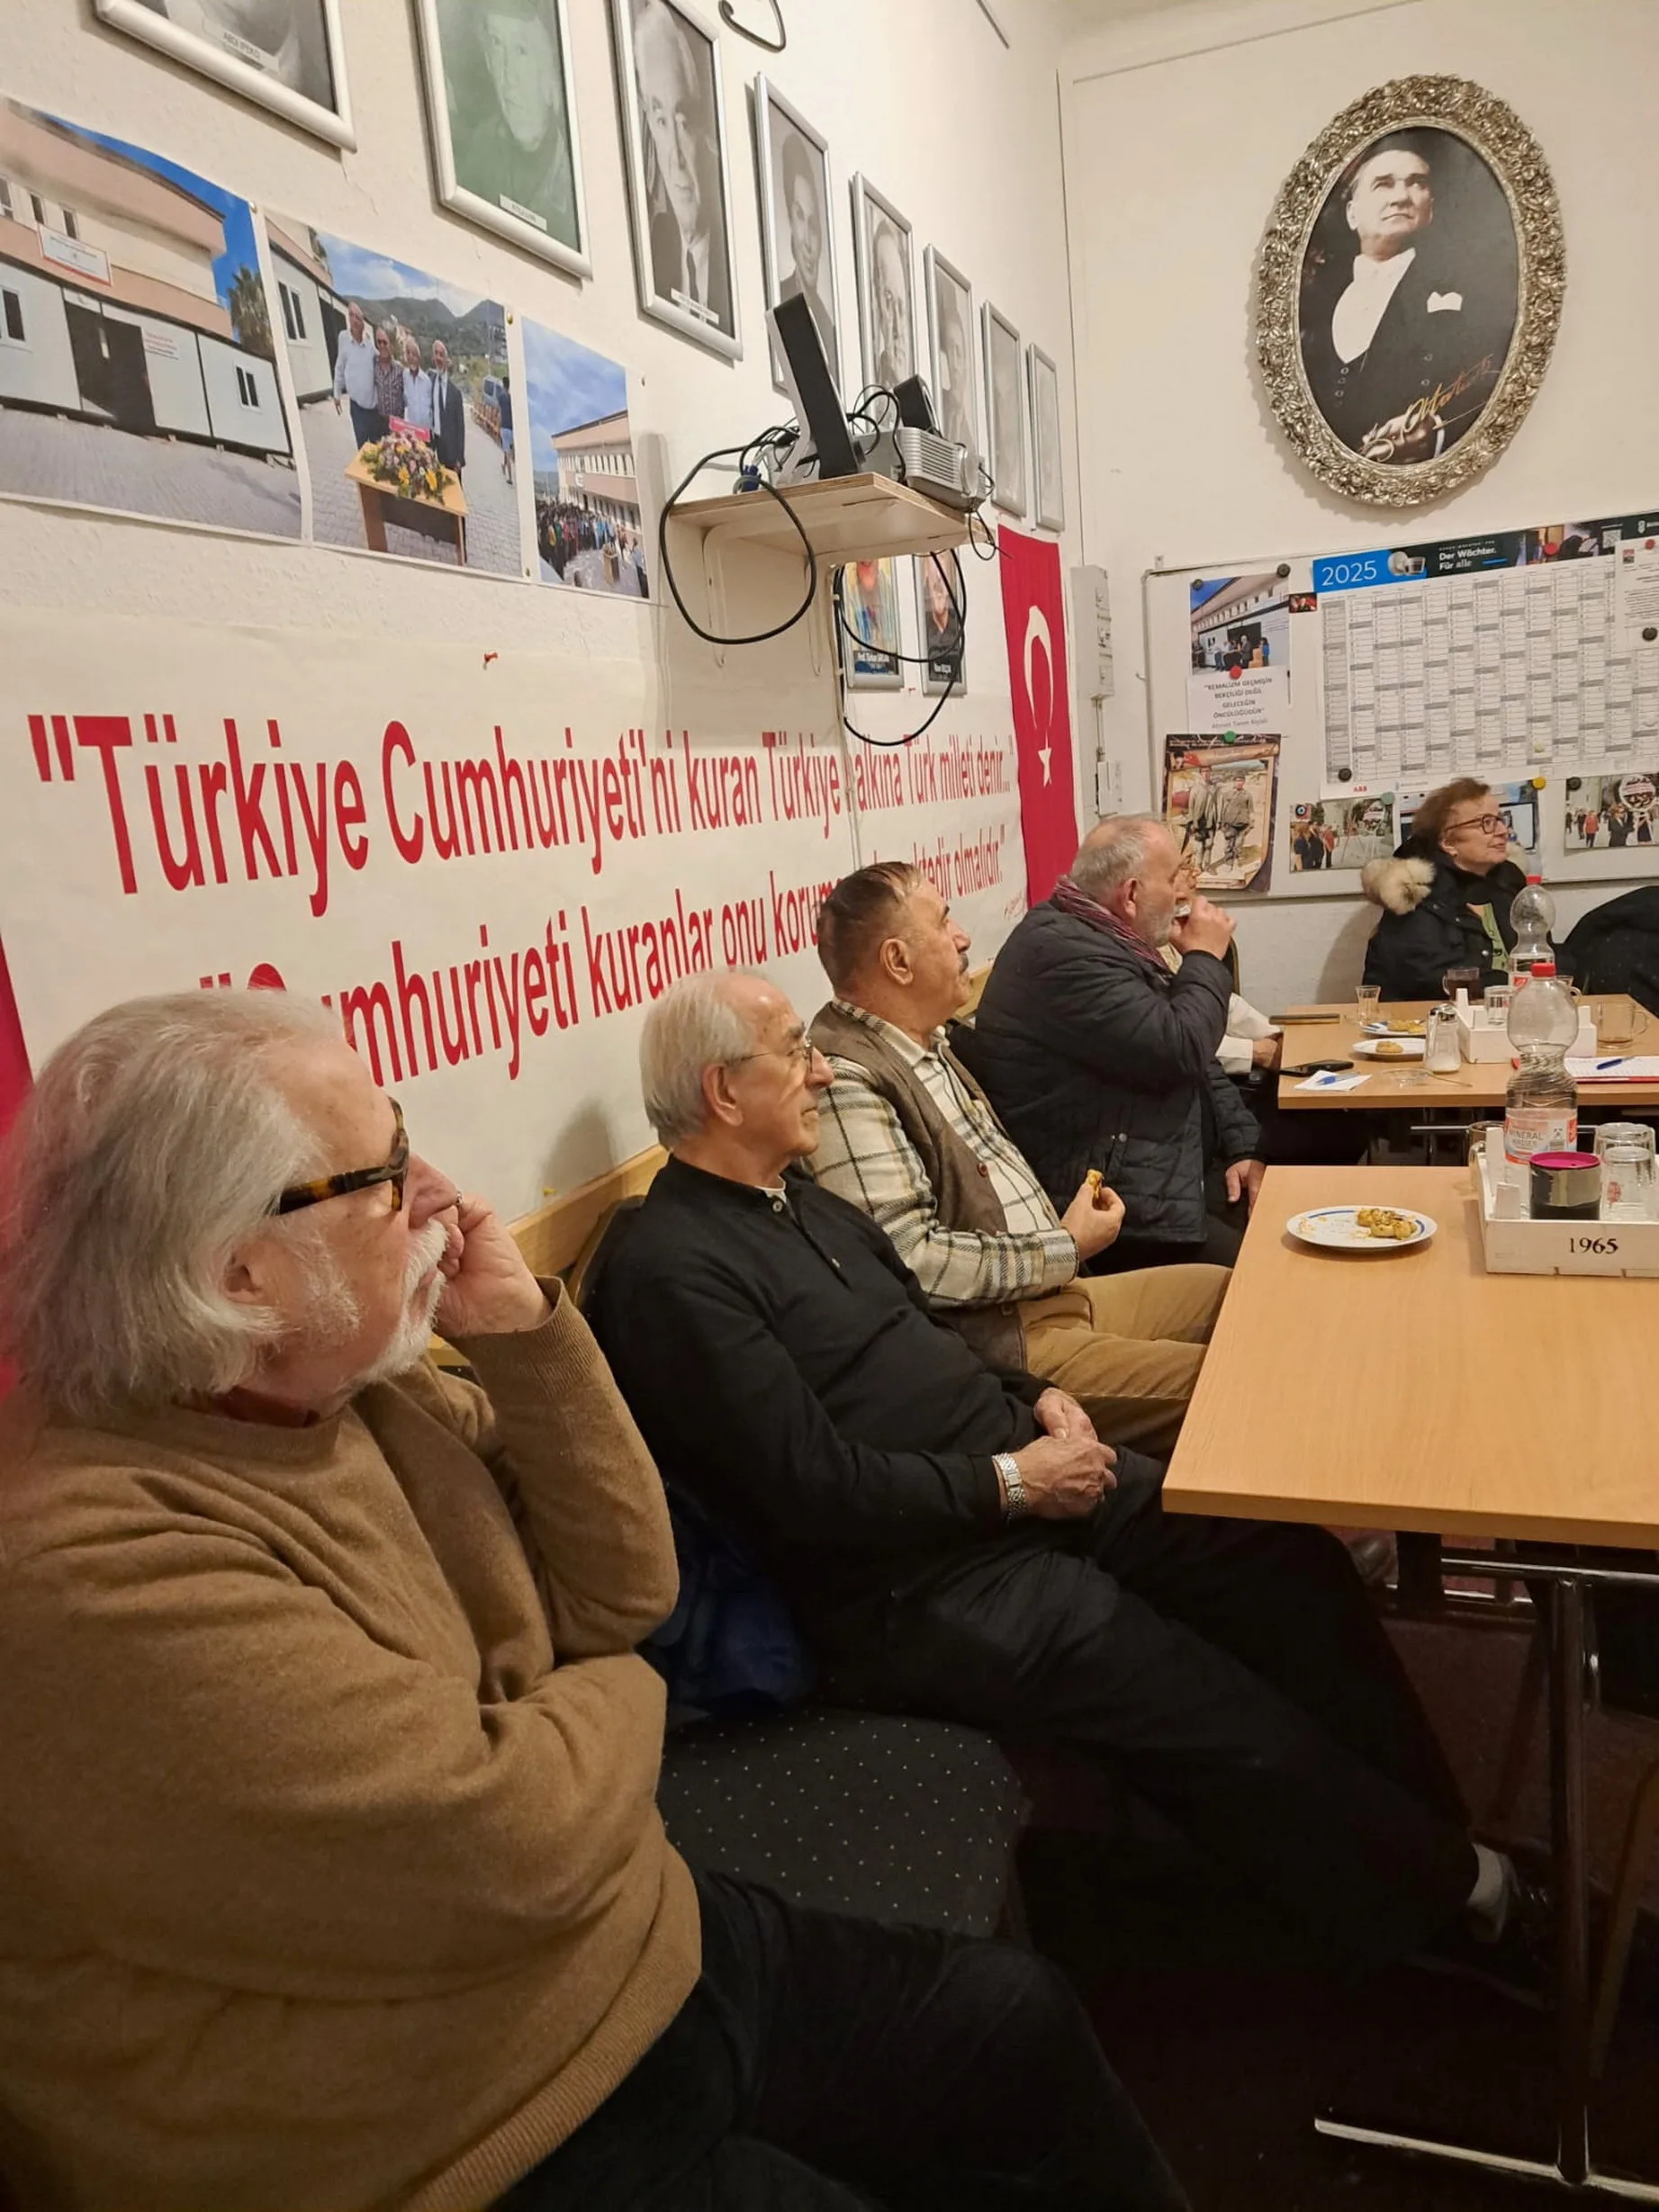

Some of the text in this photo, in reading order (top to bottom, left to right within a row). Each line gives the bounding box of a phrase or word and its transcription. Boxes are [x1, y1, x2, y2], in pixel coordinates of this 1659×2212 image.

[1438, 553, 1456, 561] Der
[1321, 560, 1377, 586] 2025
[1438, 562, 1454, 571] Für
[1353, 785, 1367, 793] ABB
[27, 714, 369, 918] "Türkiye
[382, 720, 682, 875] Cumhuriyeti'ni
[682, 730, 763, 831] kuran
[762, 731, 841, 839] Türkiye
[903, 734, 938, 805] Türk
[939, 733, 977, 799] milleti
[200, 910, 579, 1087] mhuriyeti
[581, 887, 715, 1018] kuranlar
[722, 897, 767, 966] onu
[1569, 1236, 1618, 1254] 1965
